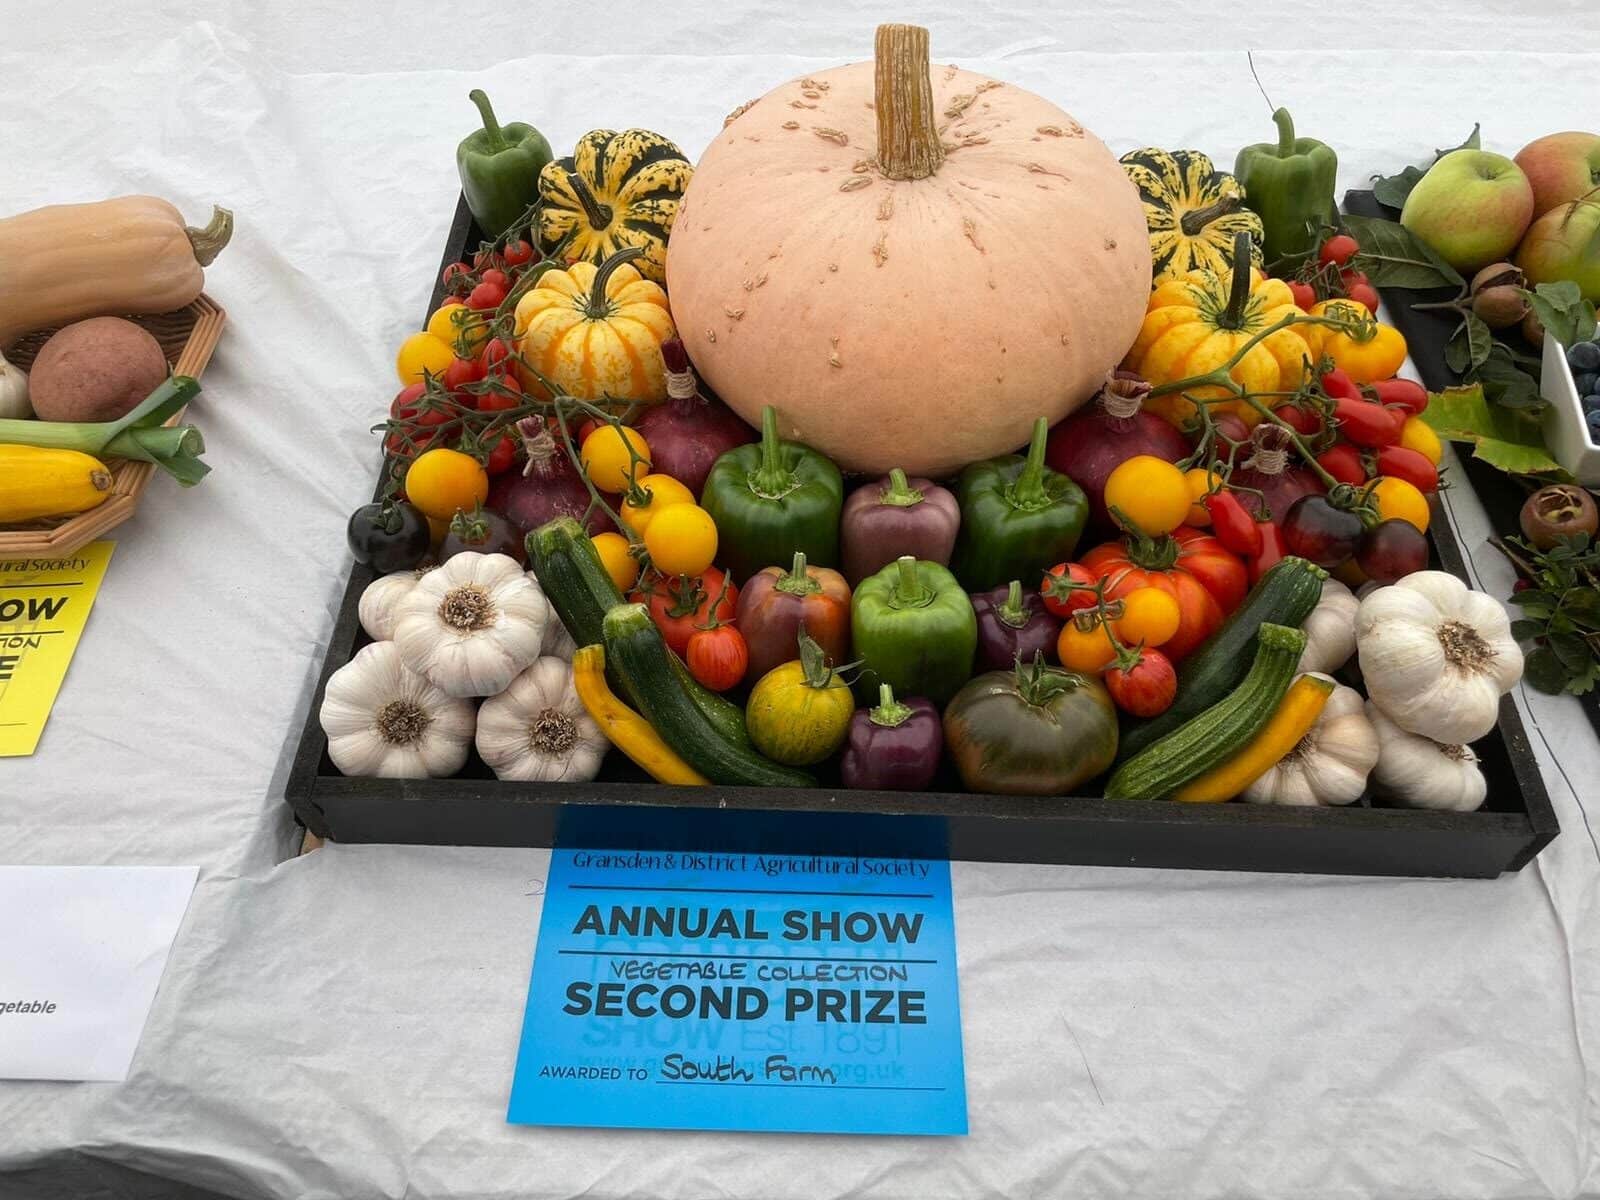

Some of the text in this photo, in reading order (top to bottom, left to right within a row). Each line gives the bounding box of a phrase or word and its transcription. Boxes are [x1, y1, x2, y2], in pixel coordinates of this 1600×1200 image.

[31, 559, 90, 572] Society
[572, 851, 930, 879] Gransden & District Agricultural Society
[572, 904, 924, 944] ANNUAL SHOW
[610, 960, 747, 981] VEGETABLE
[757, 964, 908, 983] COLLECTION
[562, 981, 928, 1025] SECOND PRIZE
[539, 1065, 622, 1080] AWARDED
[627, 1067, 648, 1081] TO
[660, 1053, 754, 1082] South
[765, 1054, 837, 1084] Farm
